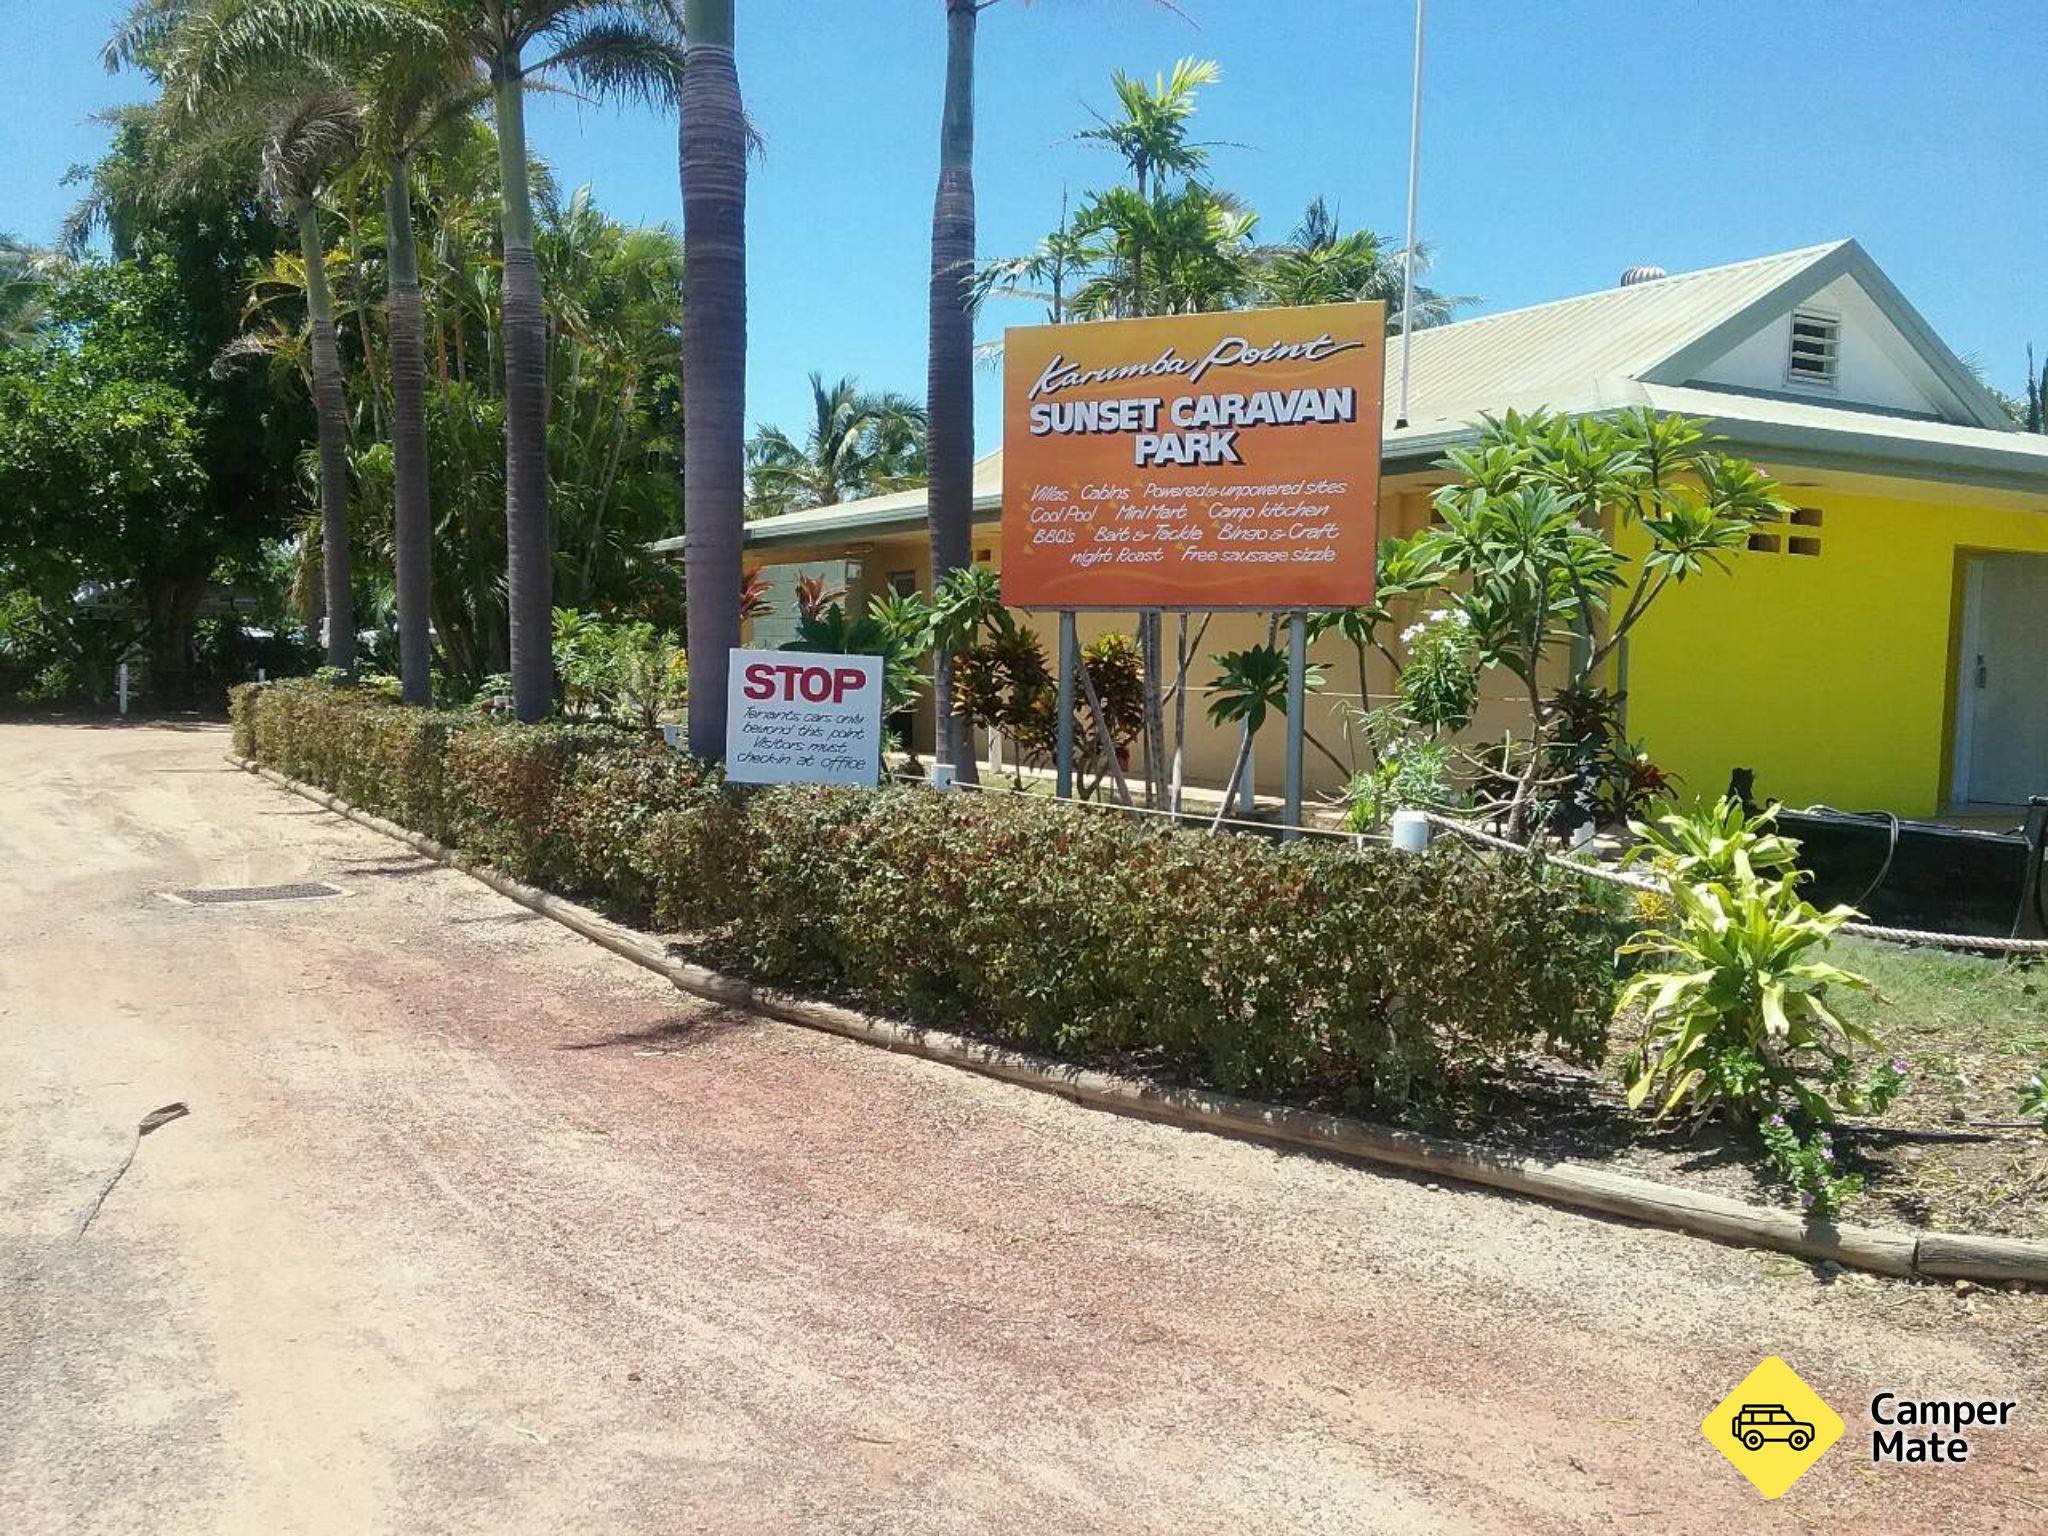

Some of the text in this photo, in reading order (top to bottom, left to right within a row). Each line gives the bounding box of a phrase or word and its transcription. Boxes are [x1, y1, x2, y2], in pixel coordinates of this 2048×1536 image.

[1028, 333, 1364, 400] Karumba Point
[1029, 386, 1356, 437] SUNSET CARAVAN
[1134, 430, 1246, 468] PARK
[1081, 482, 1131, 500] Cabins
[1143, 480, 1209, 499] Powered
[1220, 480, 1305, 501] unpowered
[1304, 479, 1348, 495] sites
[1030, 500, 1330, 523] Cool Pool Mini Mart Camp kitchen
[1032, 522, 1340, 544] BBQ's Bait & Tackle Bingo & Craft
[1070, 545, 1336, 567] night Roast Free sausage sizzle
[743, 663, 867, 704] STOP
[744, 706, 865, 725] Tenants cars only
[742, 720, 865, 741] beyond this point
[752, 735, 848, 754] Visitors must
[796, 755, 815, 767] at
[821, 755, 867, 773] office
